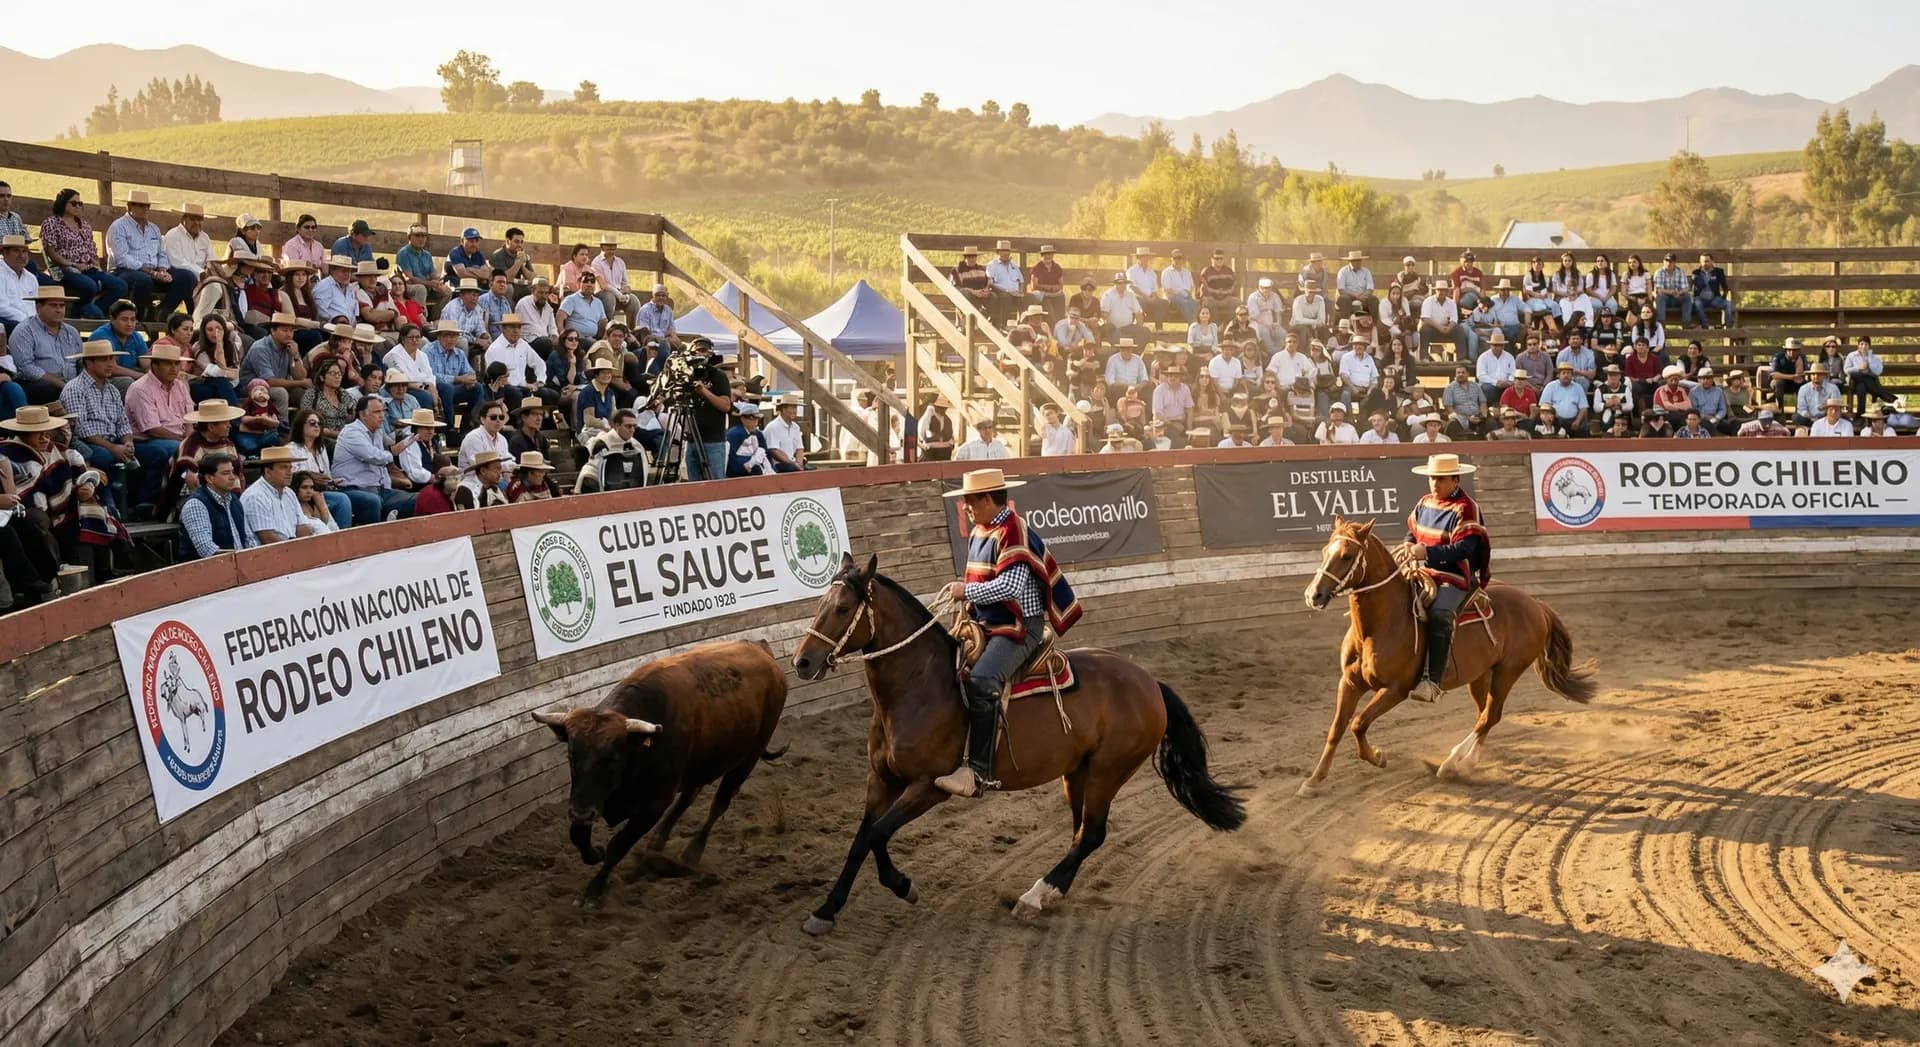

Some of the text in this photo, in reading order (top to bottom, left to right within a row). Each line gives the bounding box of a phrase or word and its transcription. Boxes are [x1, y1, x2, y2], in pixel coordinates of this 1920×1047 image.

[1290, 465, 1377, 485] DESTILERÍA
[1619, 461, 1740, 488] RODEO
[1751, 459, 1908, 487] CHILENO
[1025, 495, 1149, 529] rodeomavillo
[1270, 487, 1400, 519] EL VALLE
[1648, 491, 1880, 510] TEMPORADA OFICIAL
[598, 519, 656, 554] CLUB
[658, 515, 689, 544] DE
[691, 505, 766, 540] RODEO
[606, 558, 654, 609] EL
[656, 538, 776, 598] SAUCE
[223, 569, 473, 666] FEDERACIÓN NACIONAL DE
[662, 592, 737, 620] FUNDADO 1928
[234, 647, 353, 735] RODEO
[357, 608, 483, 686] CHILENO
